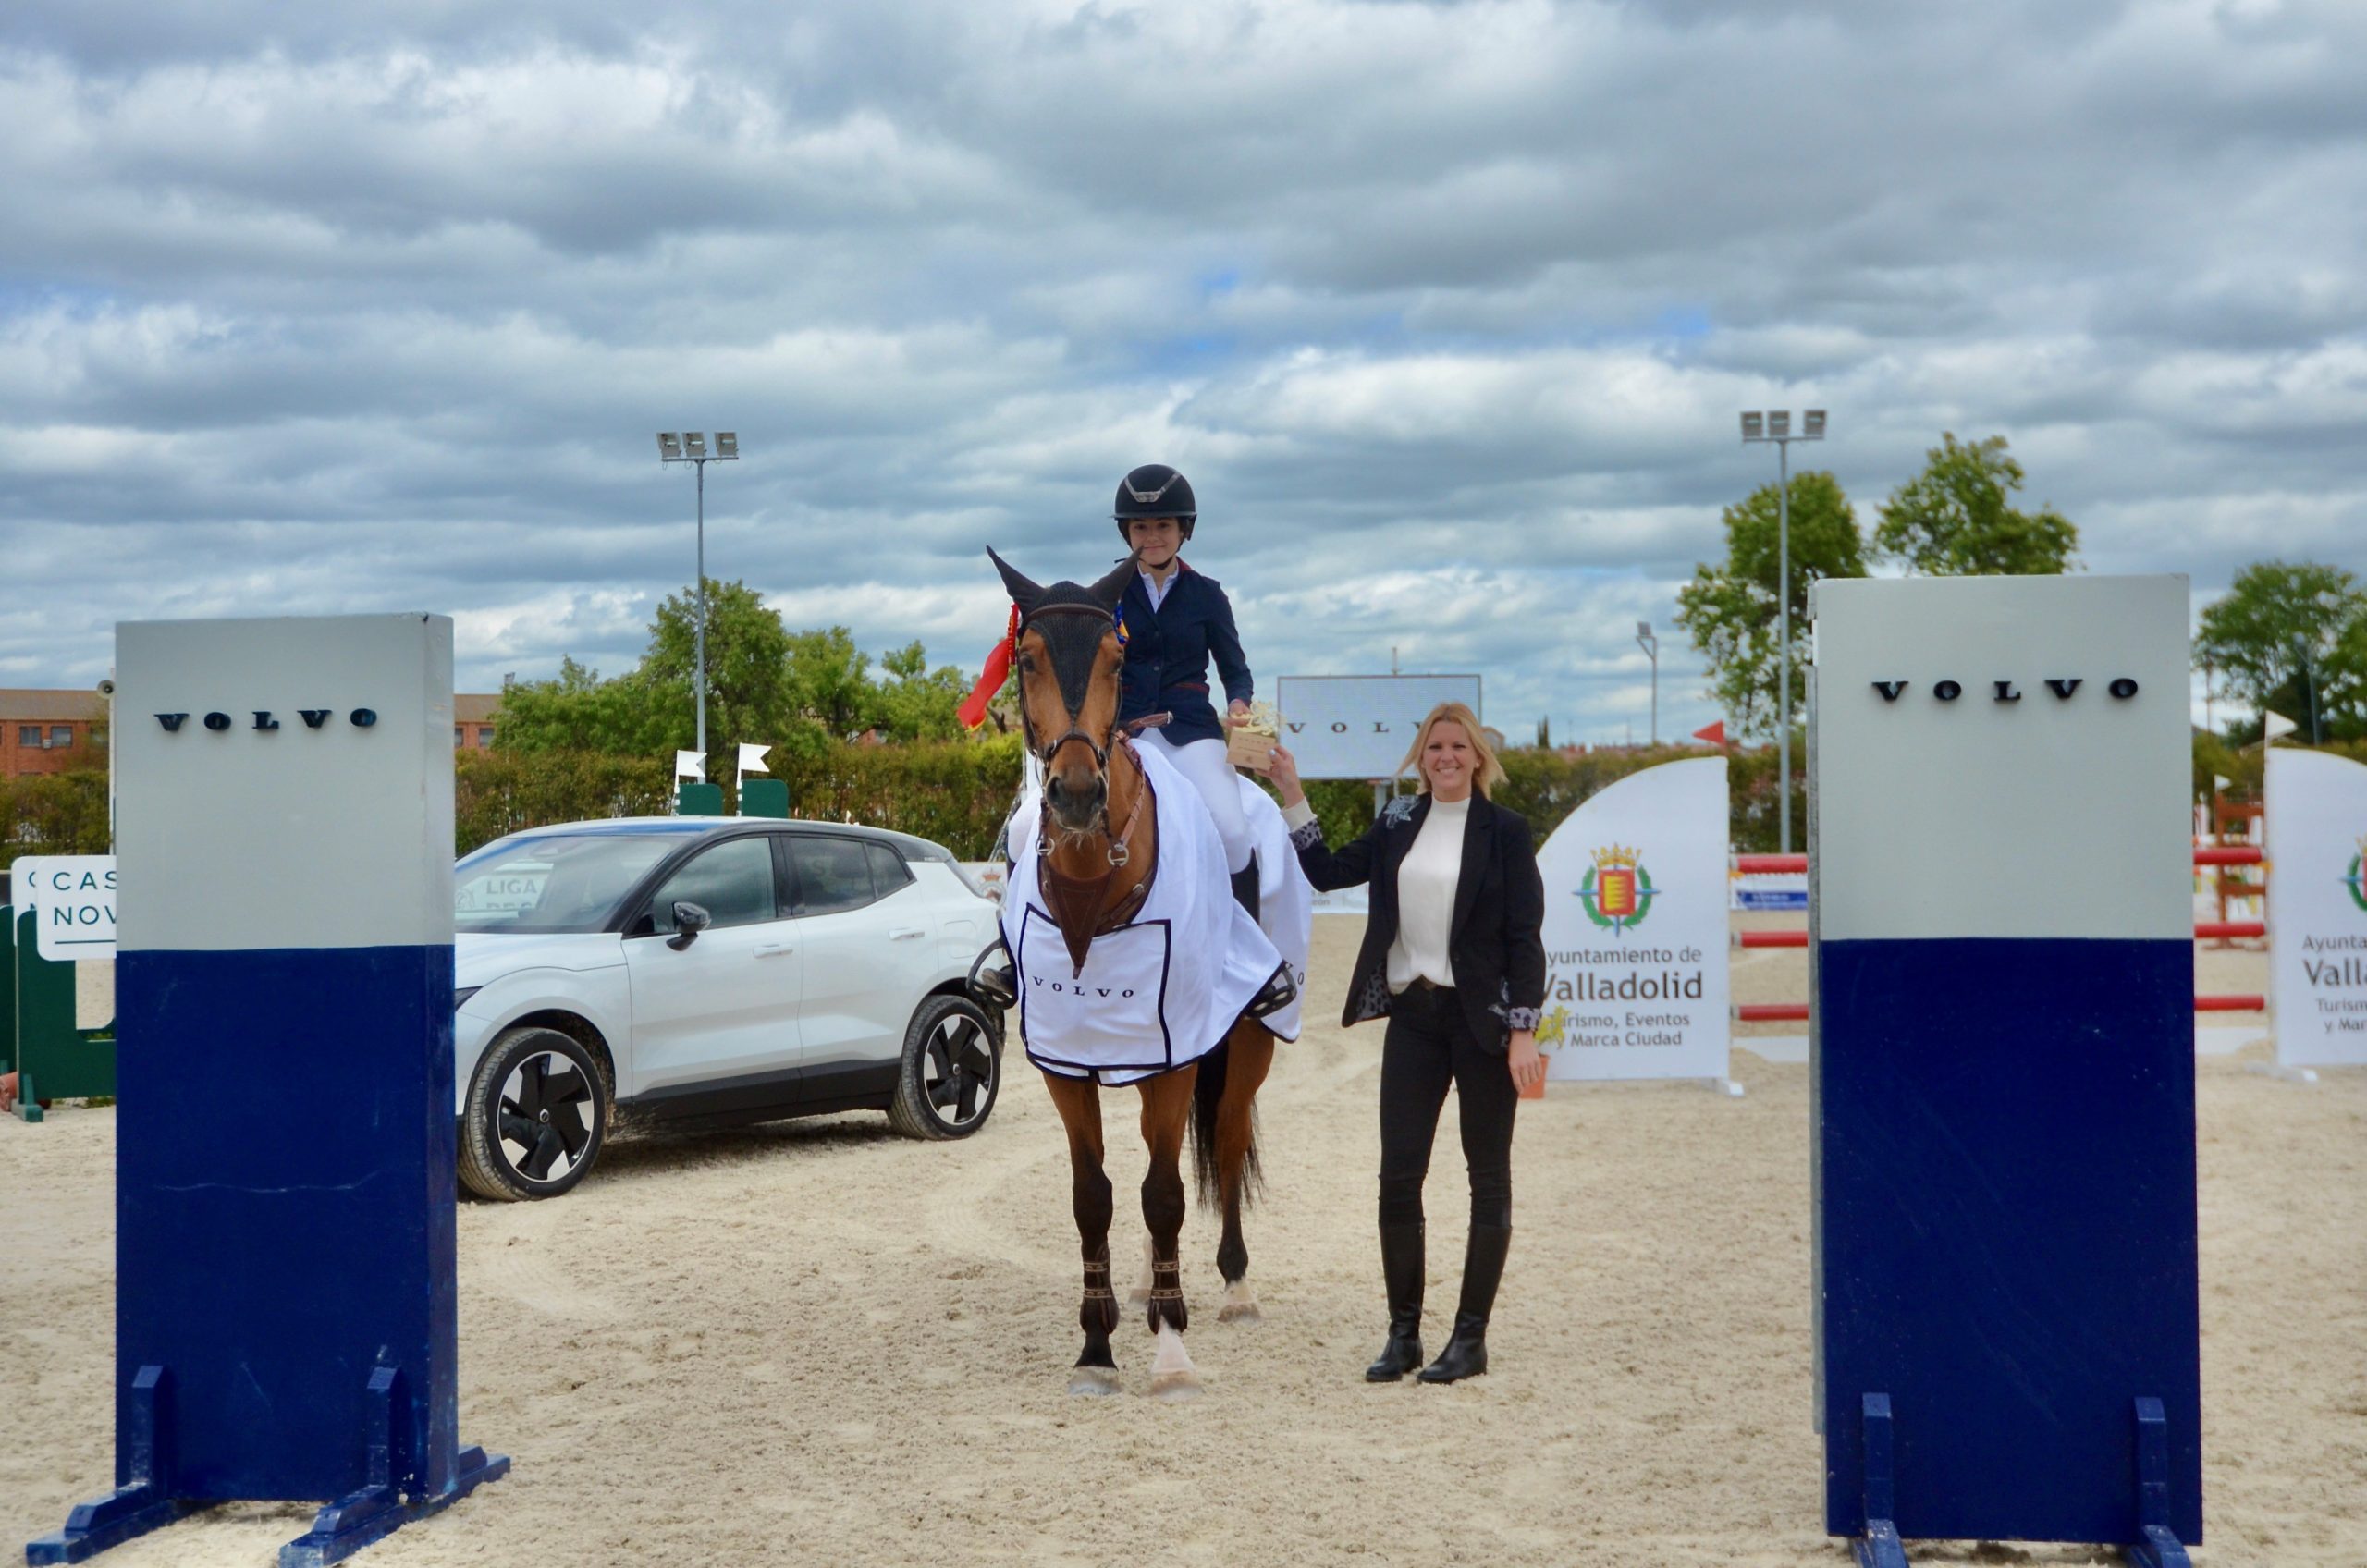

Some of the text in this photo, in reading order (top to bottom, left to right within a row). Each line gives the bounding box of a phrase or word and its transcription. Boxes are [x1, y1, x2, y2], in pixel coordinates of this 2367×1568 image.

[1871, 678, 2139, 702] VOLVO
[153, 708, 377, 731] VOLVO
[486, 879, 537, 894] LIGA
[1547, 946, 1702, 968] yuntamiento de
[2302, 957, 2367, 986] Vall
[1033, 976, 1134, 998] VOLVO
[1625, 1012, 1690, 1027] Eventos
[1570, 1033, 1620, 1047] Marca
[1625, 1031, 1683, 1047] Ciudad
